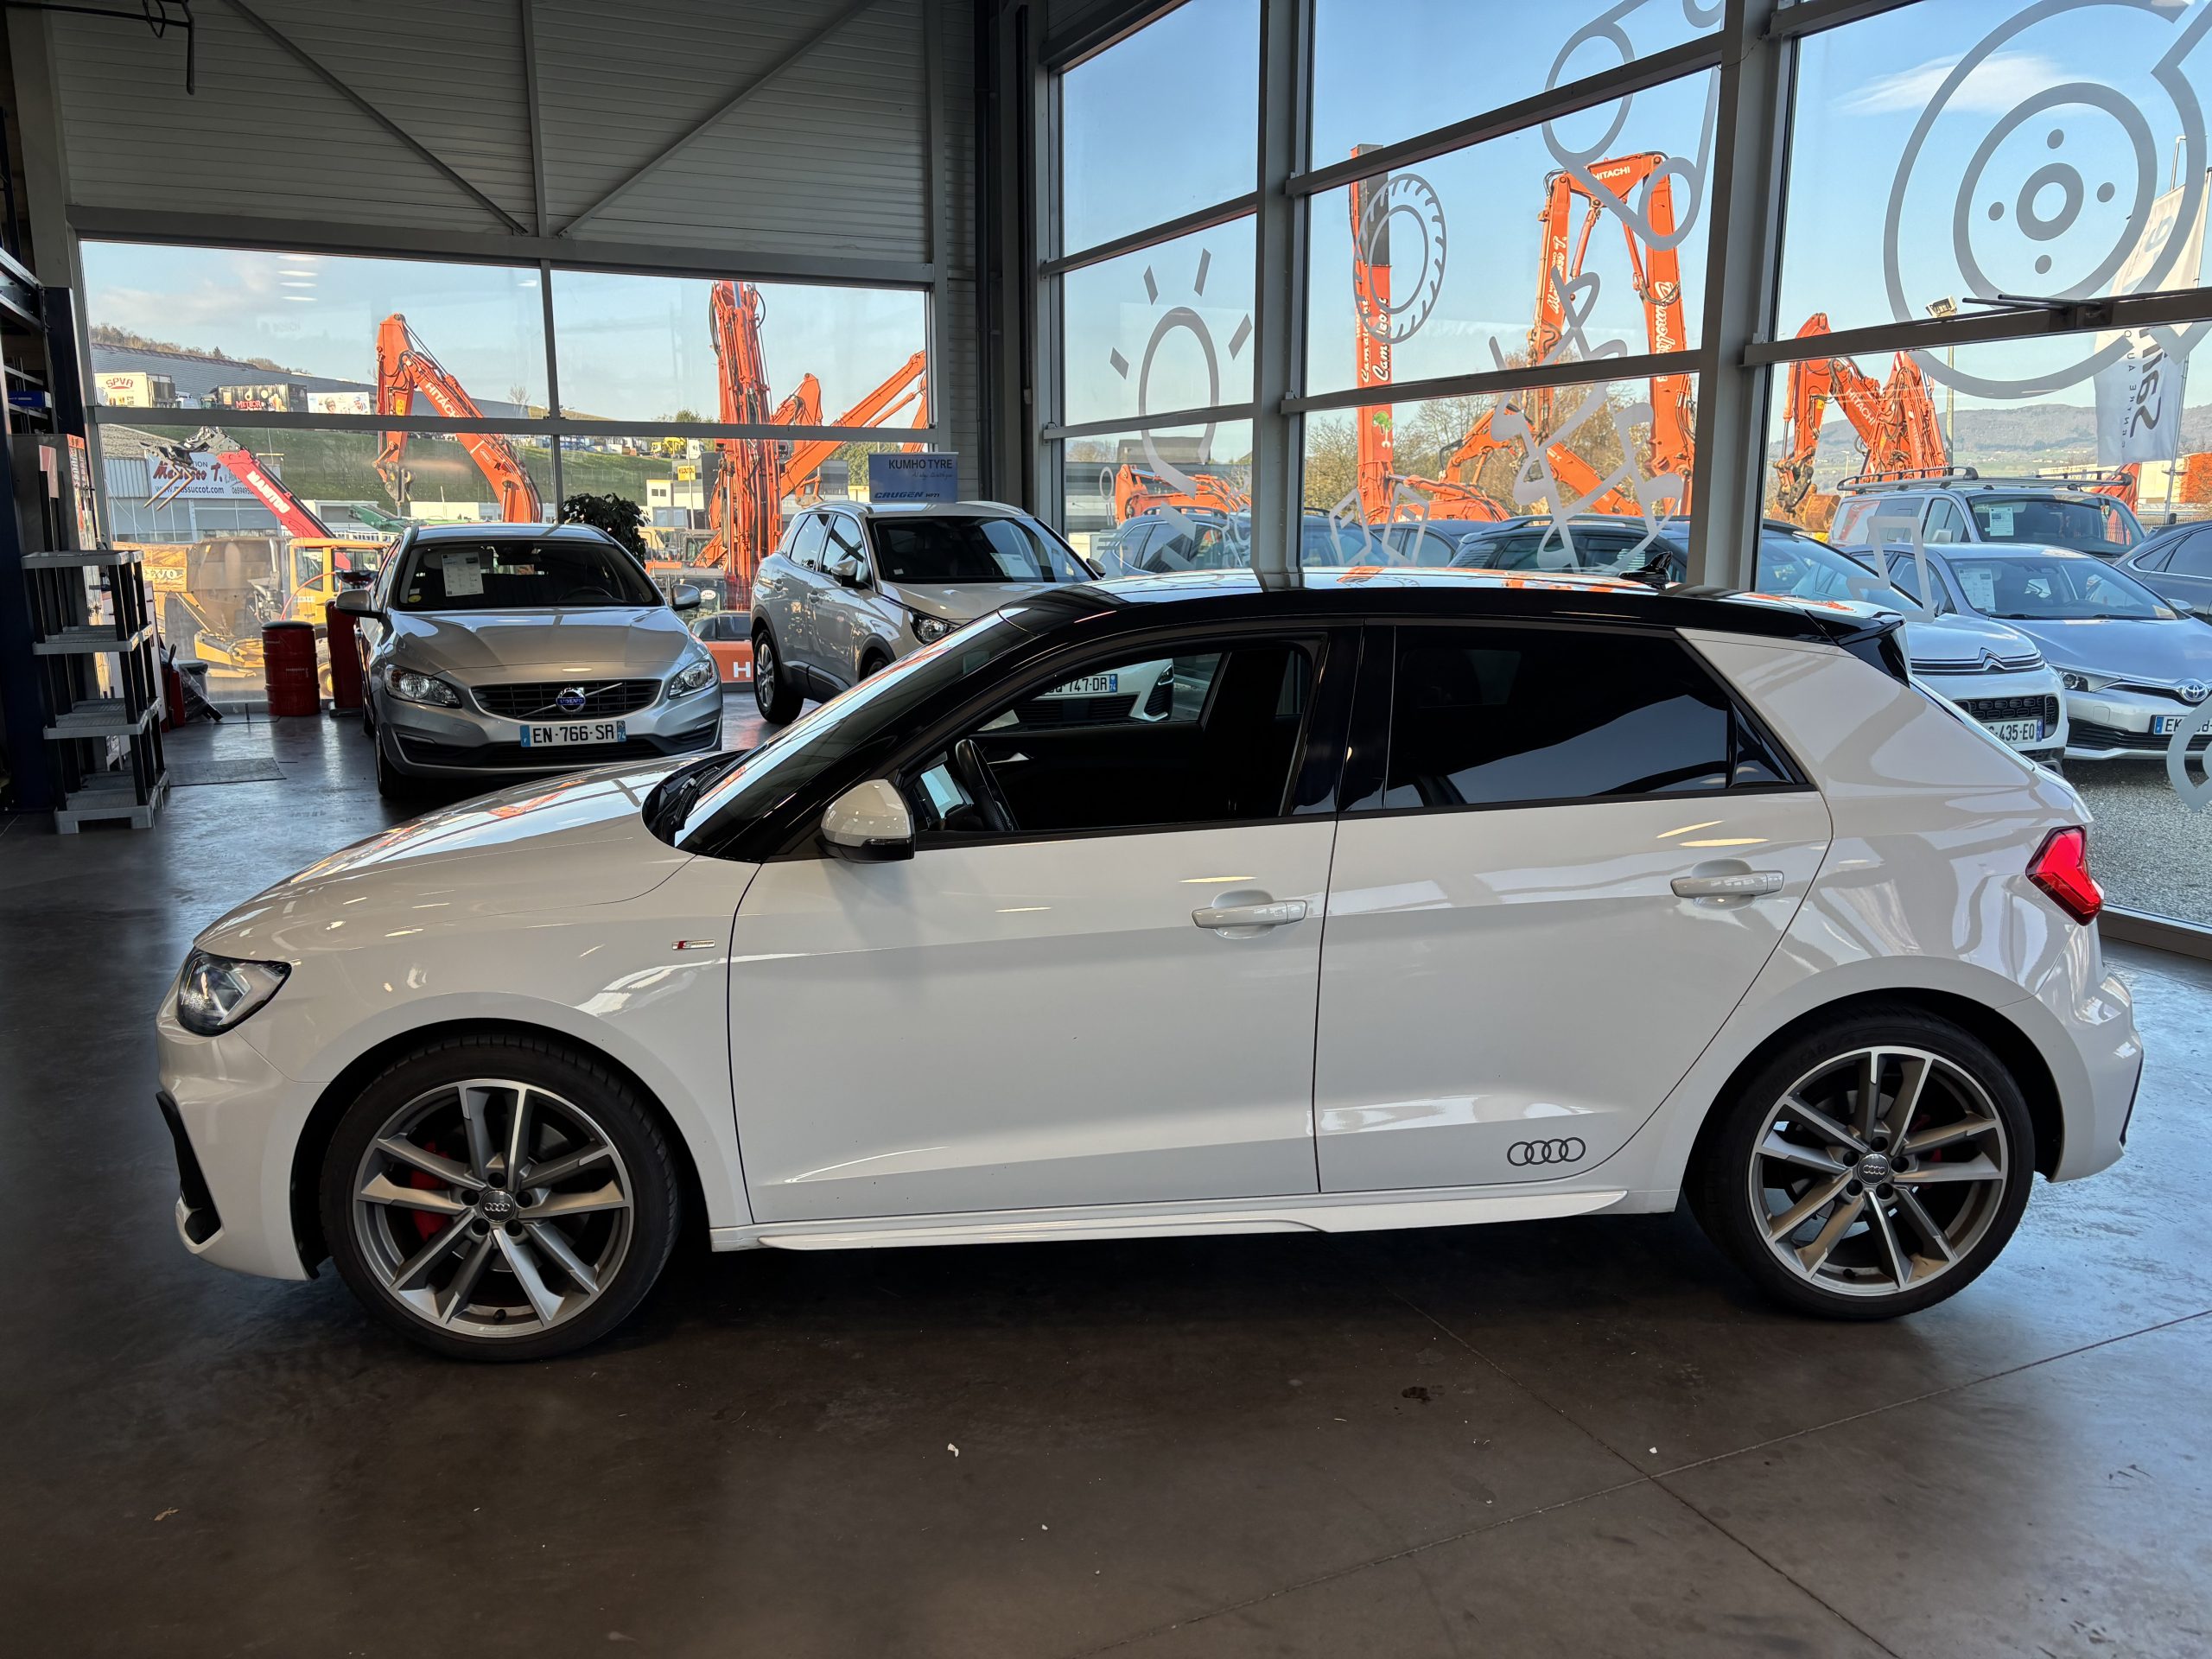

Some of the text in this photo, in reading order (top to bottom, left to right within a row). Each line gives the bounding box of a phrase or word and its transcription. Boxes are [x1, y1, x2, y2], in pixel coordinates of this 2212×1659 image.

[1592, 166, 1630, 181] HITACHI
[1846, 388, 1877, 426] HITACHI
[211, 462, 223, 482] T.
[888, 459, 953, 470] KUMHO TYRE
[246, 471, 291, 514] MANITOU
[532, 724, 614, 744] EN-766-SR
[618, 731, 626, 740] 74
